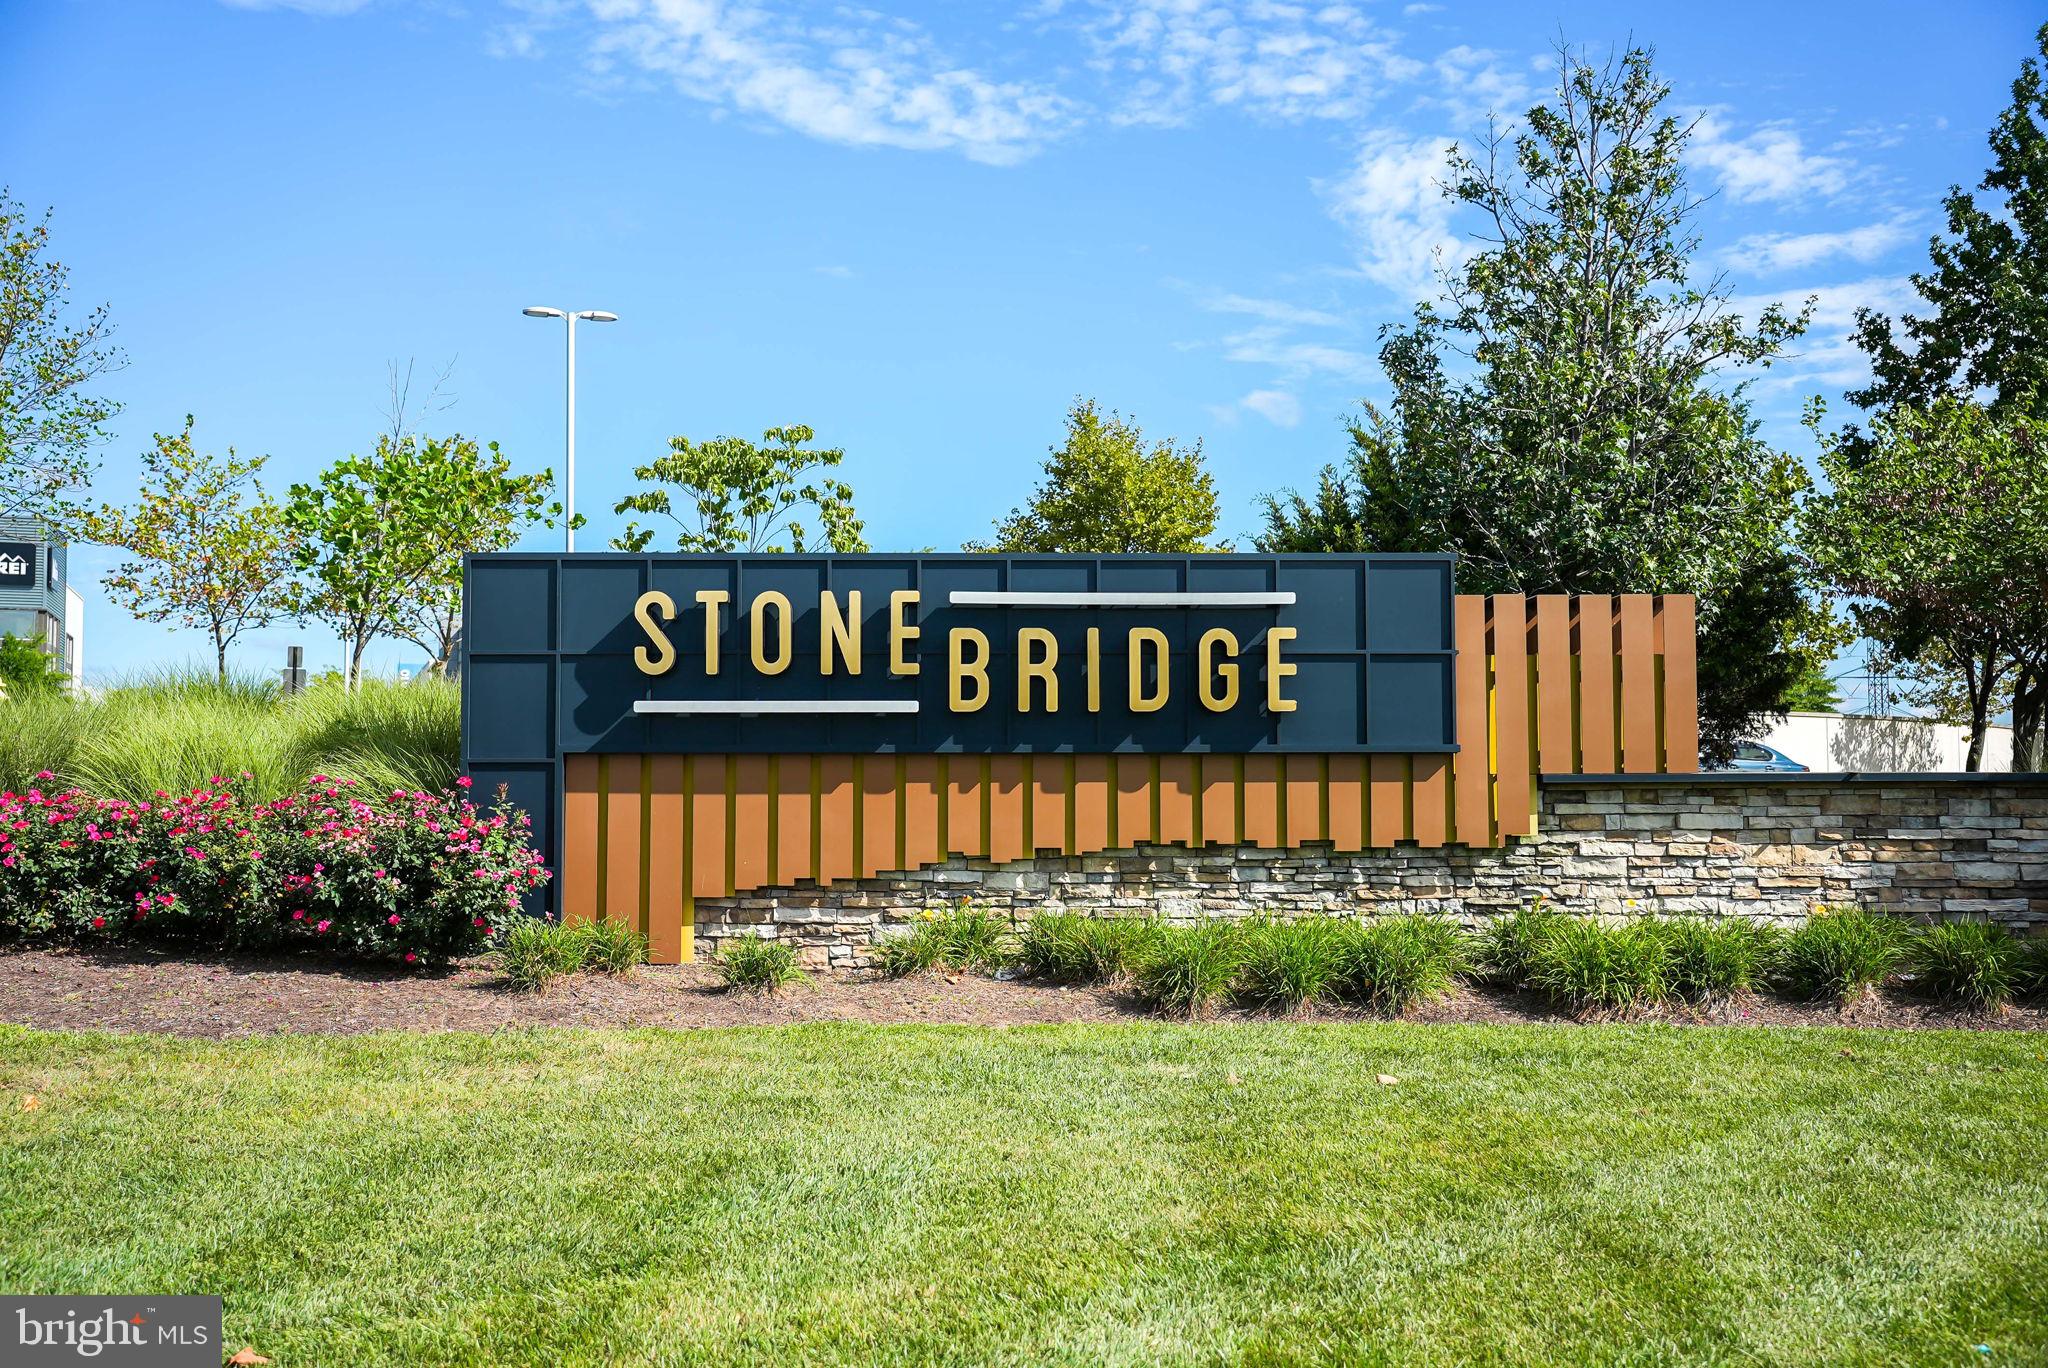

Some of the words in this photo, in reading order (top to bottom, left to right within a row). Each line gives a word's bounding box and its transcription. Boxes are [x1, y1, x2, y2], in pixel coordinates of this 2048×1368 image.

[0, 561, 26, 575] REI
[634, 590, 921, 675] STONE
[949, 627, 1298, 712] BRIDGE
